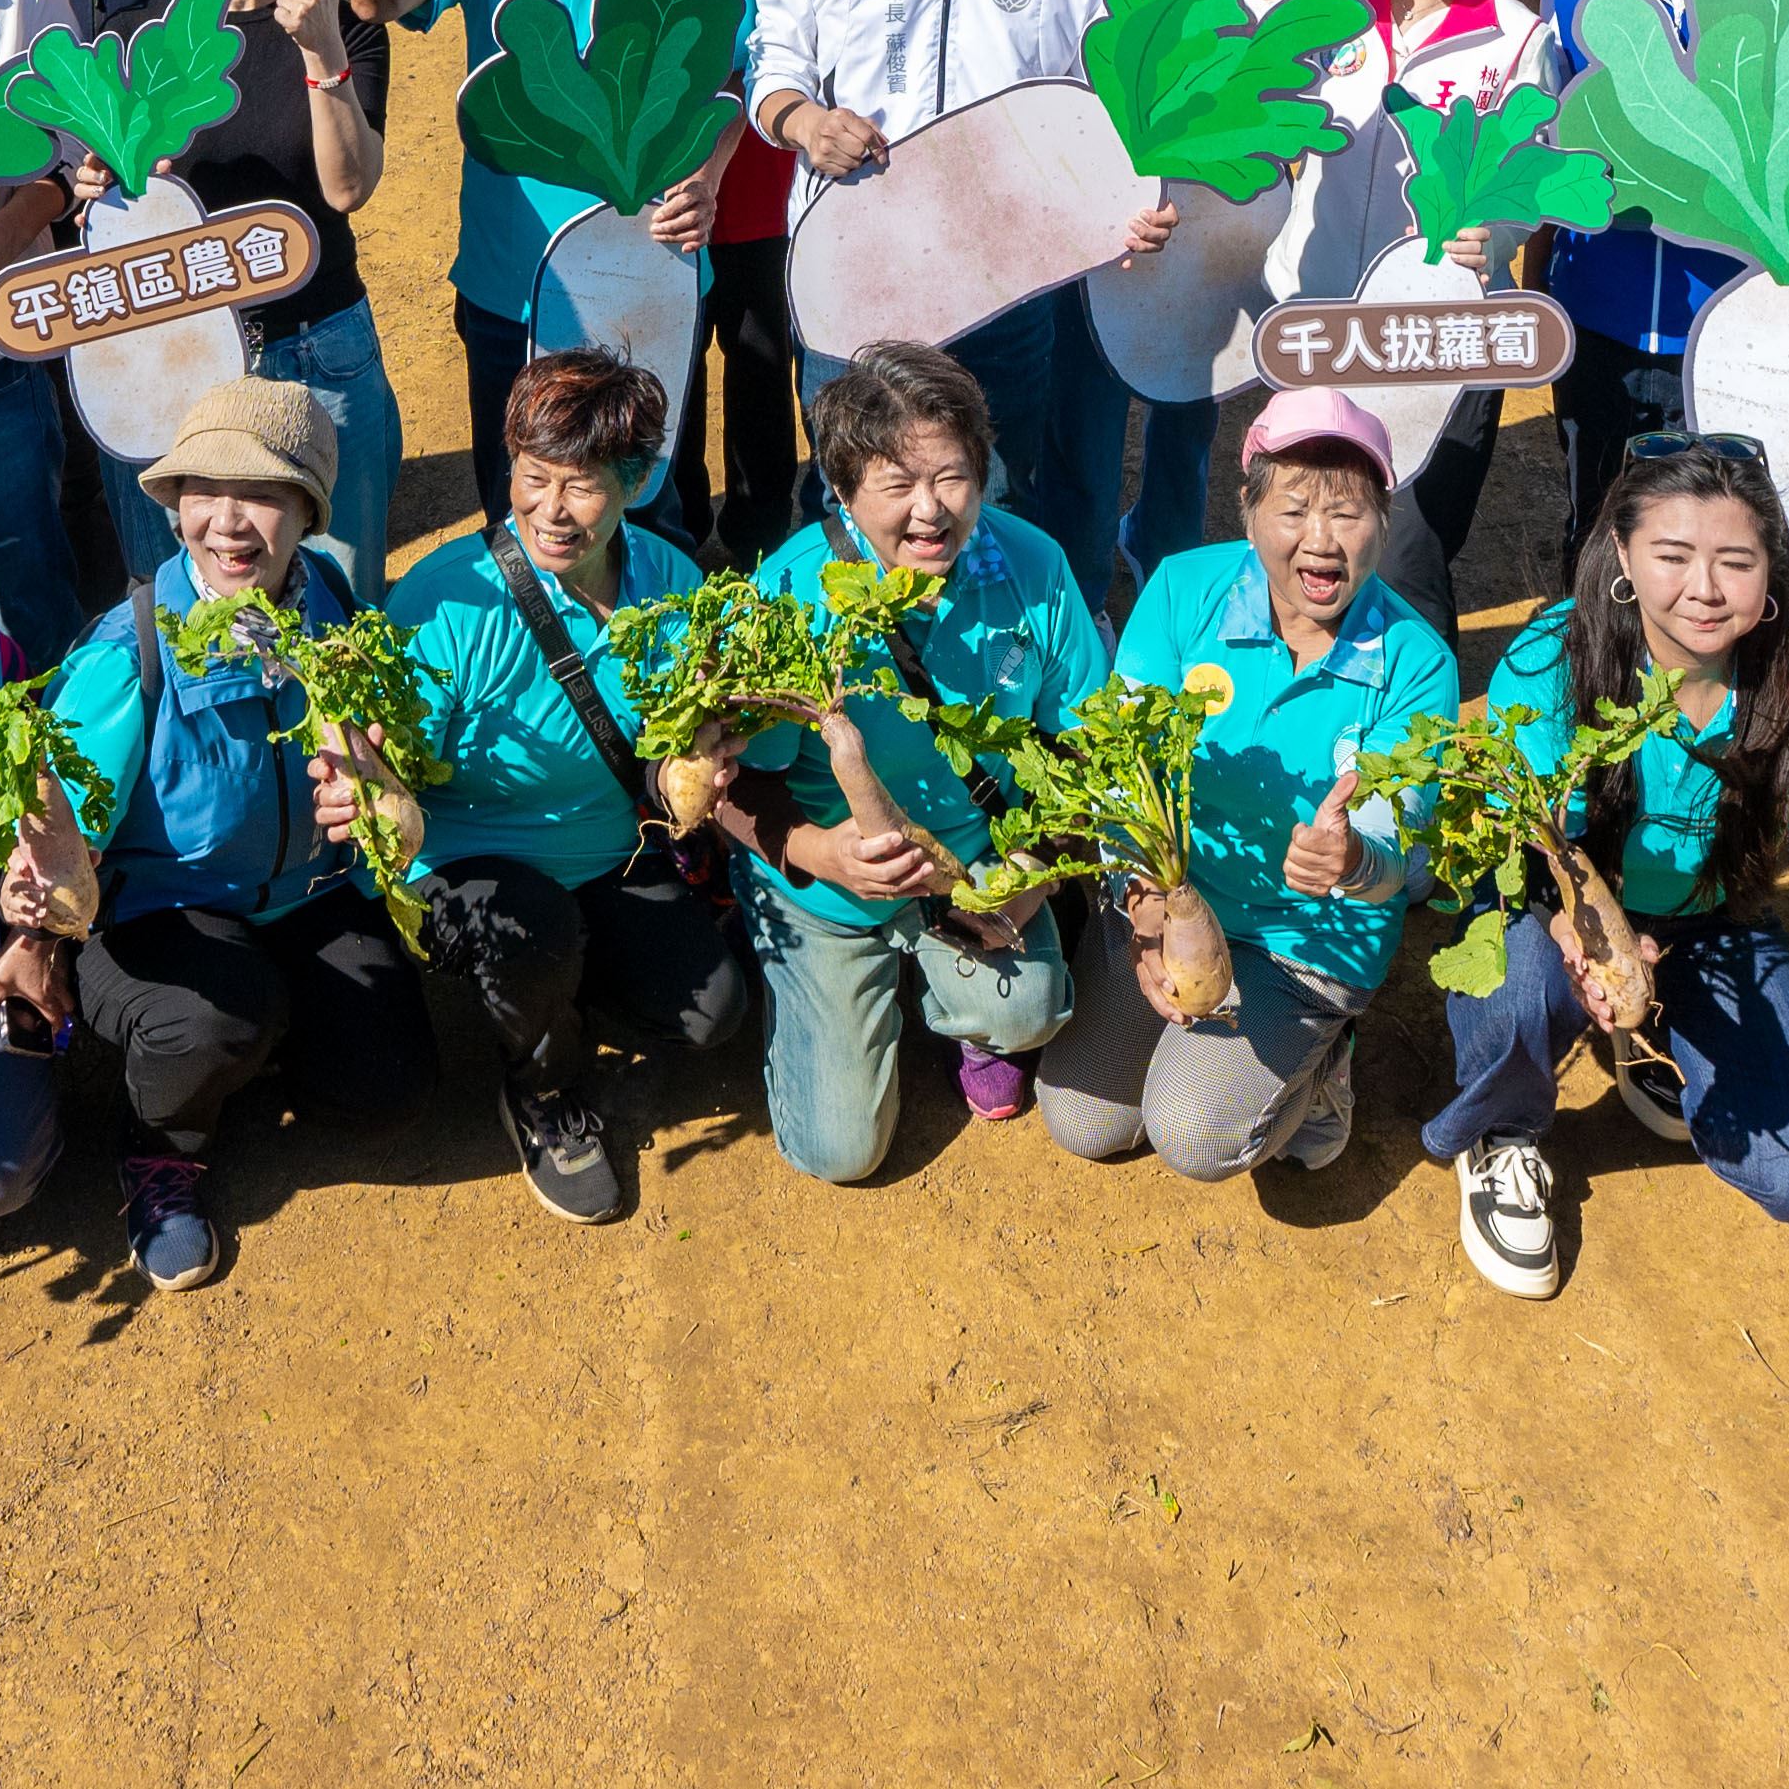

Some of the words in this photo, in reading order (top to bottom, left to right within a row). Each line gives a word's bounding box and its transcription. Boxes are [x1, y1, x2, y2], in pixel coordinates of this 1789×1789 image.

[885, 32, 908, 95] 蘇俊賓
[10, 225, 290, 339] 平鎮區農會
[1276, 310, 1540, 375] 千人拔蘿蔔
